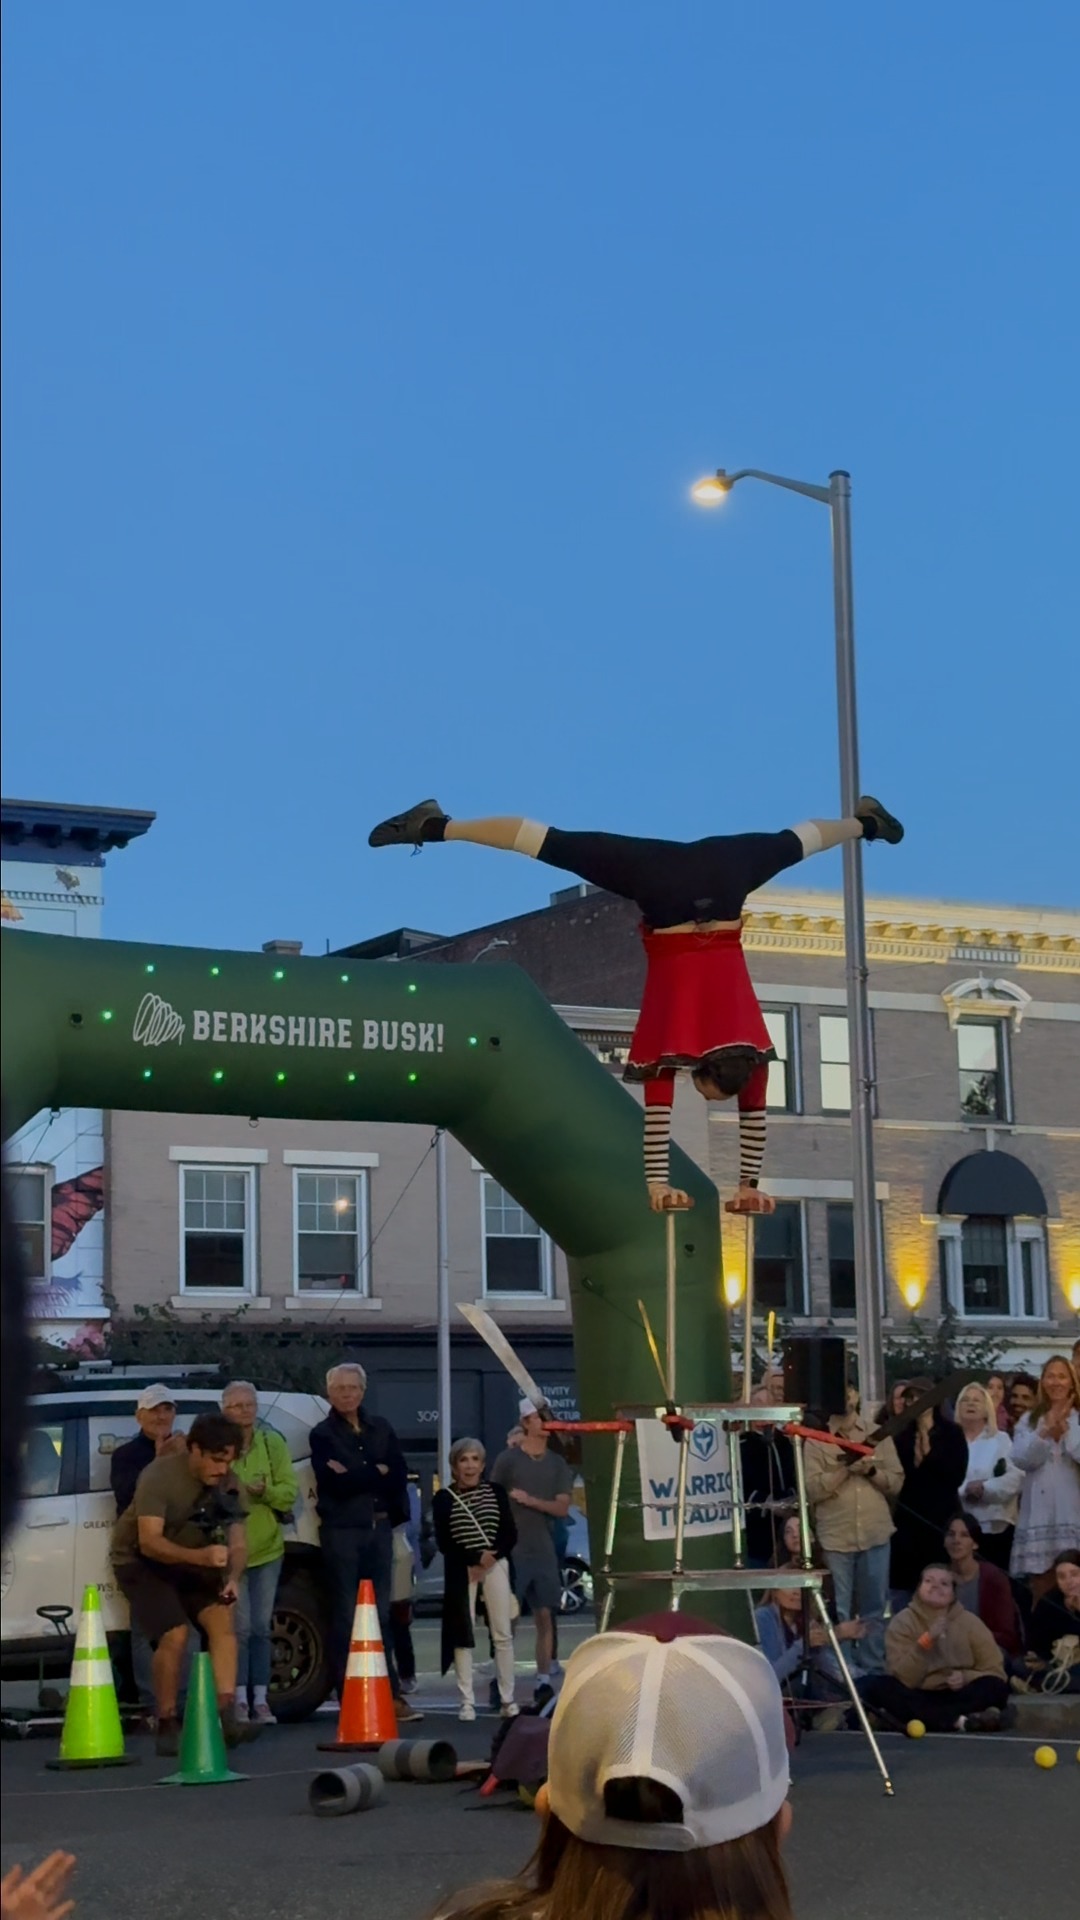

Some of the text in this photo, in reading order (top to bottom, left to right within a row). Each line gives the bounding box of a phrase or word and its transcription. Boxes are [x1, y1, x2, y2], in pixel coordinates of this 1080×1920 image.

[193, 1010, 444, 1052] BERKSHIRE BUSK!
[518, 1386, 570, 1396] CTIVITY
[416, 1410, 439, 1422] 309
[649, 1470, 740, 1498] WARRIO
[656, 1499, 741, 1526] TRADI
